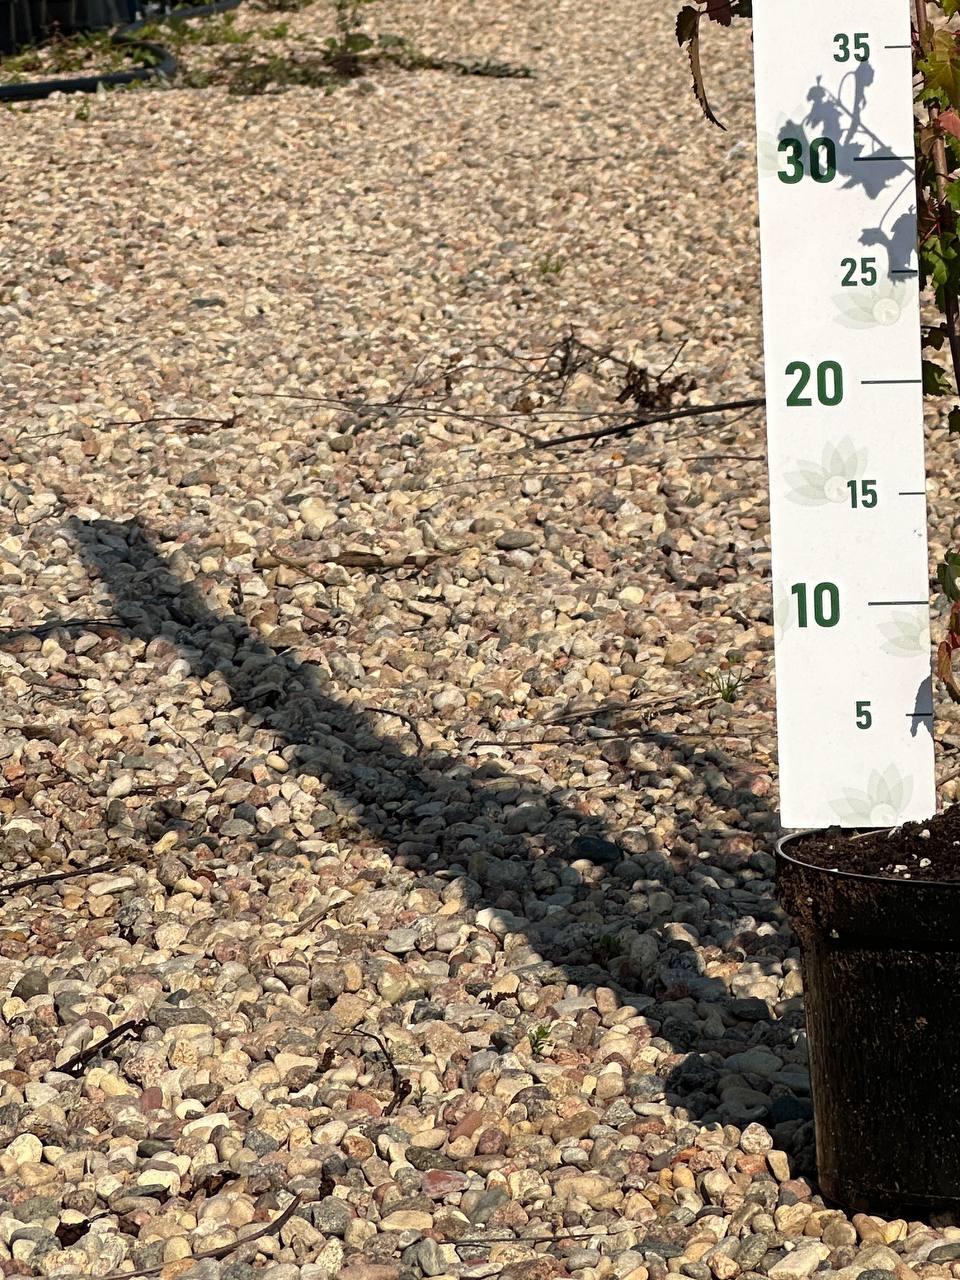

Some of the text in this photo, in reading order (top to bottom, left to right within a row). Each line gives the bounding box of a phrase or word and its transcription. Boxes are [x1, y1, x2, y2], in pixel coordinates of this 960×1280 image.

[833, 32, 871, 63] 35
[777, 133, 838, 184] 30
[840, 257, 877, 287] 25
[784, 360, 844, 407] 20
[847, 479, 878, 509] 15
[791, 582, 840, 628] 10
[856, 700, 872, 730] 5
